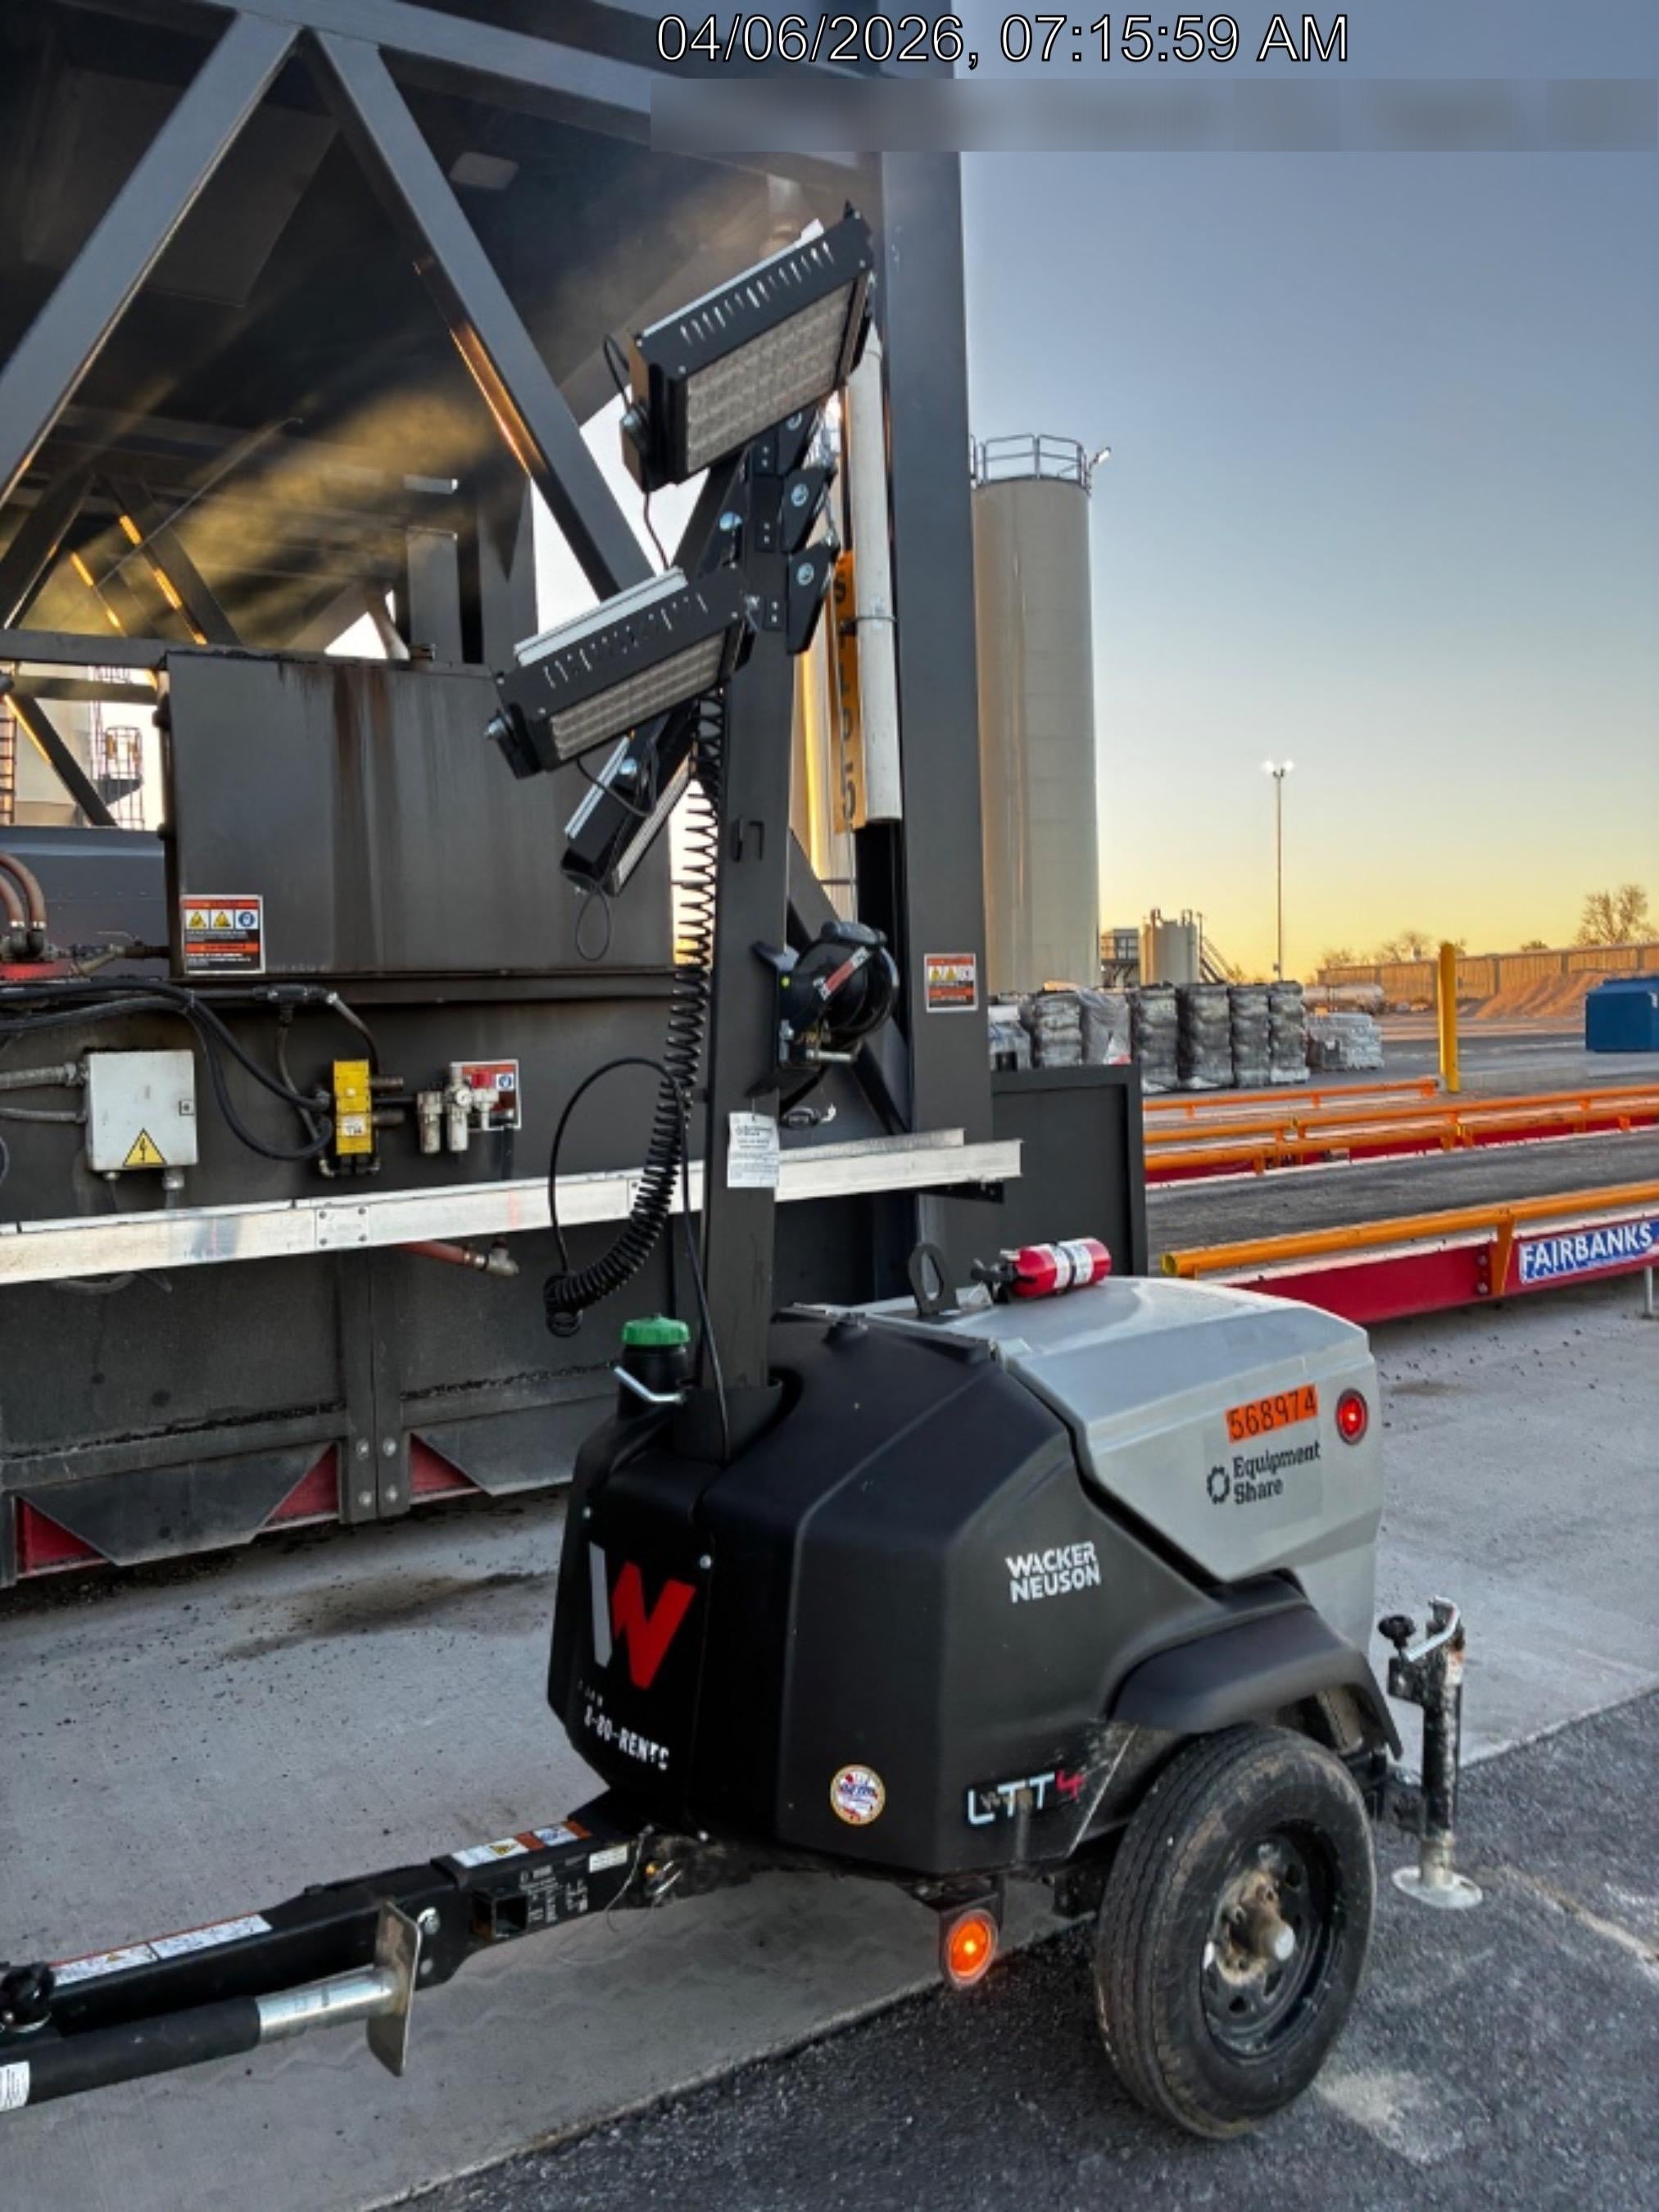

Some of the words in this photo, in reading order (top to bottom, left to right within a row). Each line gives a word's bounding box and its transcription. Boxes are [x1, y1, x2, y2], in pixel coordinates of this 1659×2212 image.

[1521, 1221, 1653, 1281] FAIRBANKS
[1227, 1385, 1317, 1441] 568974
[1233, 1439, 1321, 1480] Equipment
[1234, 1478, 1284, 1505] Share
[1004, 1540, 1097, 1579] WACKER
[1009, 1560, 1101, 1603] NEUSON
